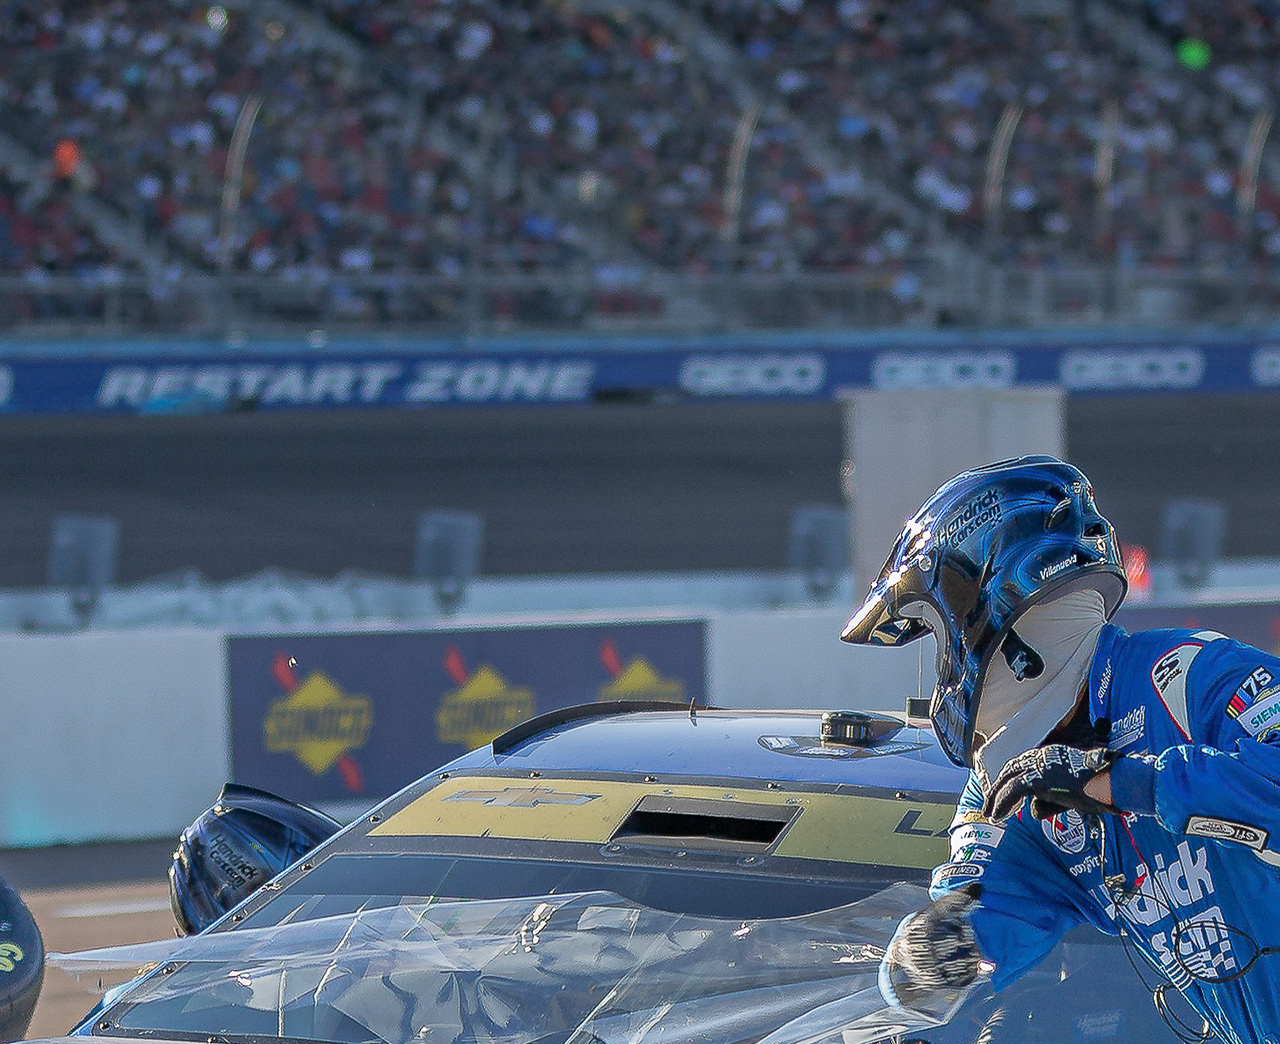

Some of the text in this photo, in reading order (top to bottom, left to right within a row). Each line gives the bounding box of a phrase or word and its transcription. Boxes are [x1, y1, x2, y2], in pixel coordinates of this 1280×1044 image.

[98, 363, 403, 408] RESTART
[405, 360, 596, 403] ZONE
[935, 489, 998, 546] Hendrick
[950, 505, 1001, 547] Cars.com
[1242, 667, 1272, 697] 75
[211, 835, 259, 879] Hendrick
